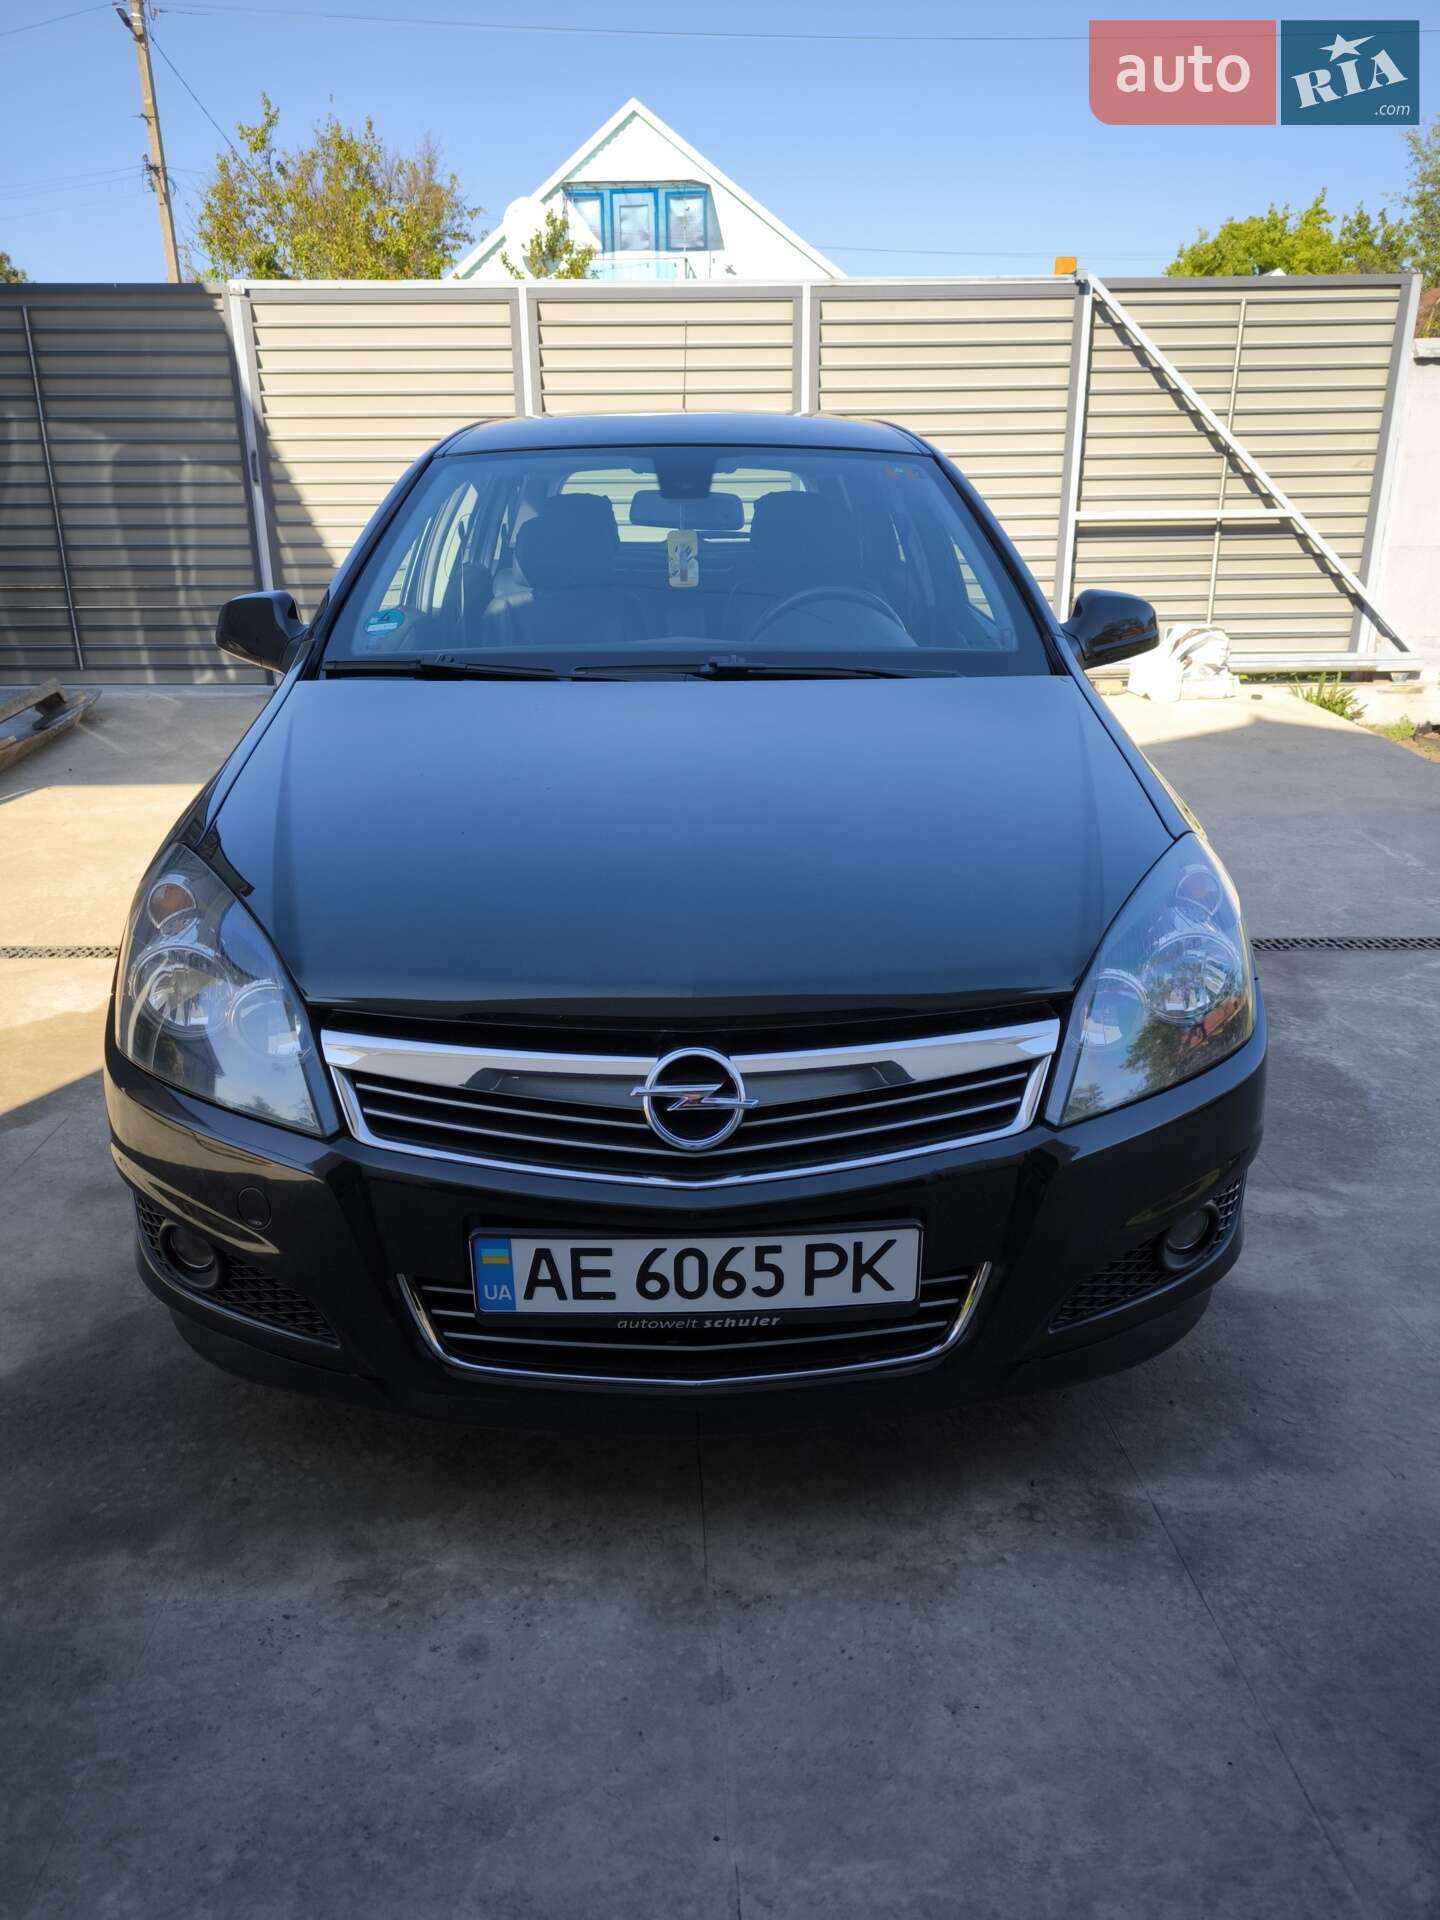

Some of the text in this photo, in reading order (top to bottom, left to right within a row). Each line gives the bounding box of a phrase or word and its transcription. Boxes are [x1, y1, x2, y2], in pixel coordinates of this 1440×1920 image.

[523, 1238, 898, 1300] AE 6065 PK
[484, 1284, 512, 1300] UA
[617, 1316, 781, 1329] autowelt schuler
